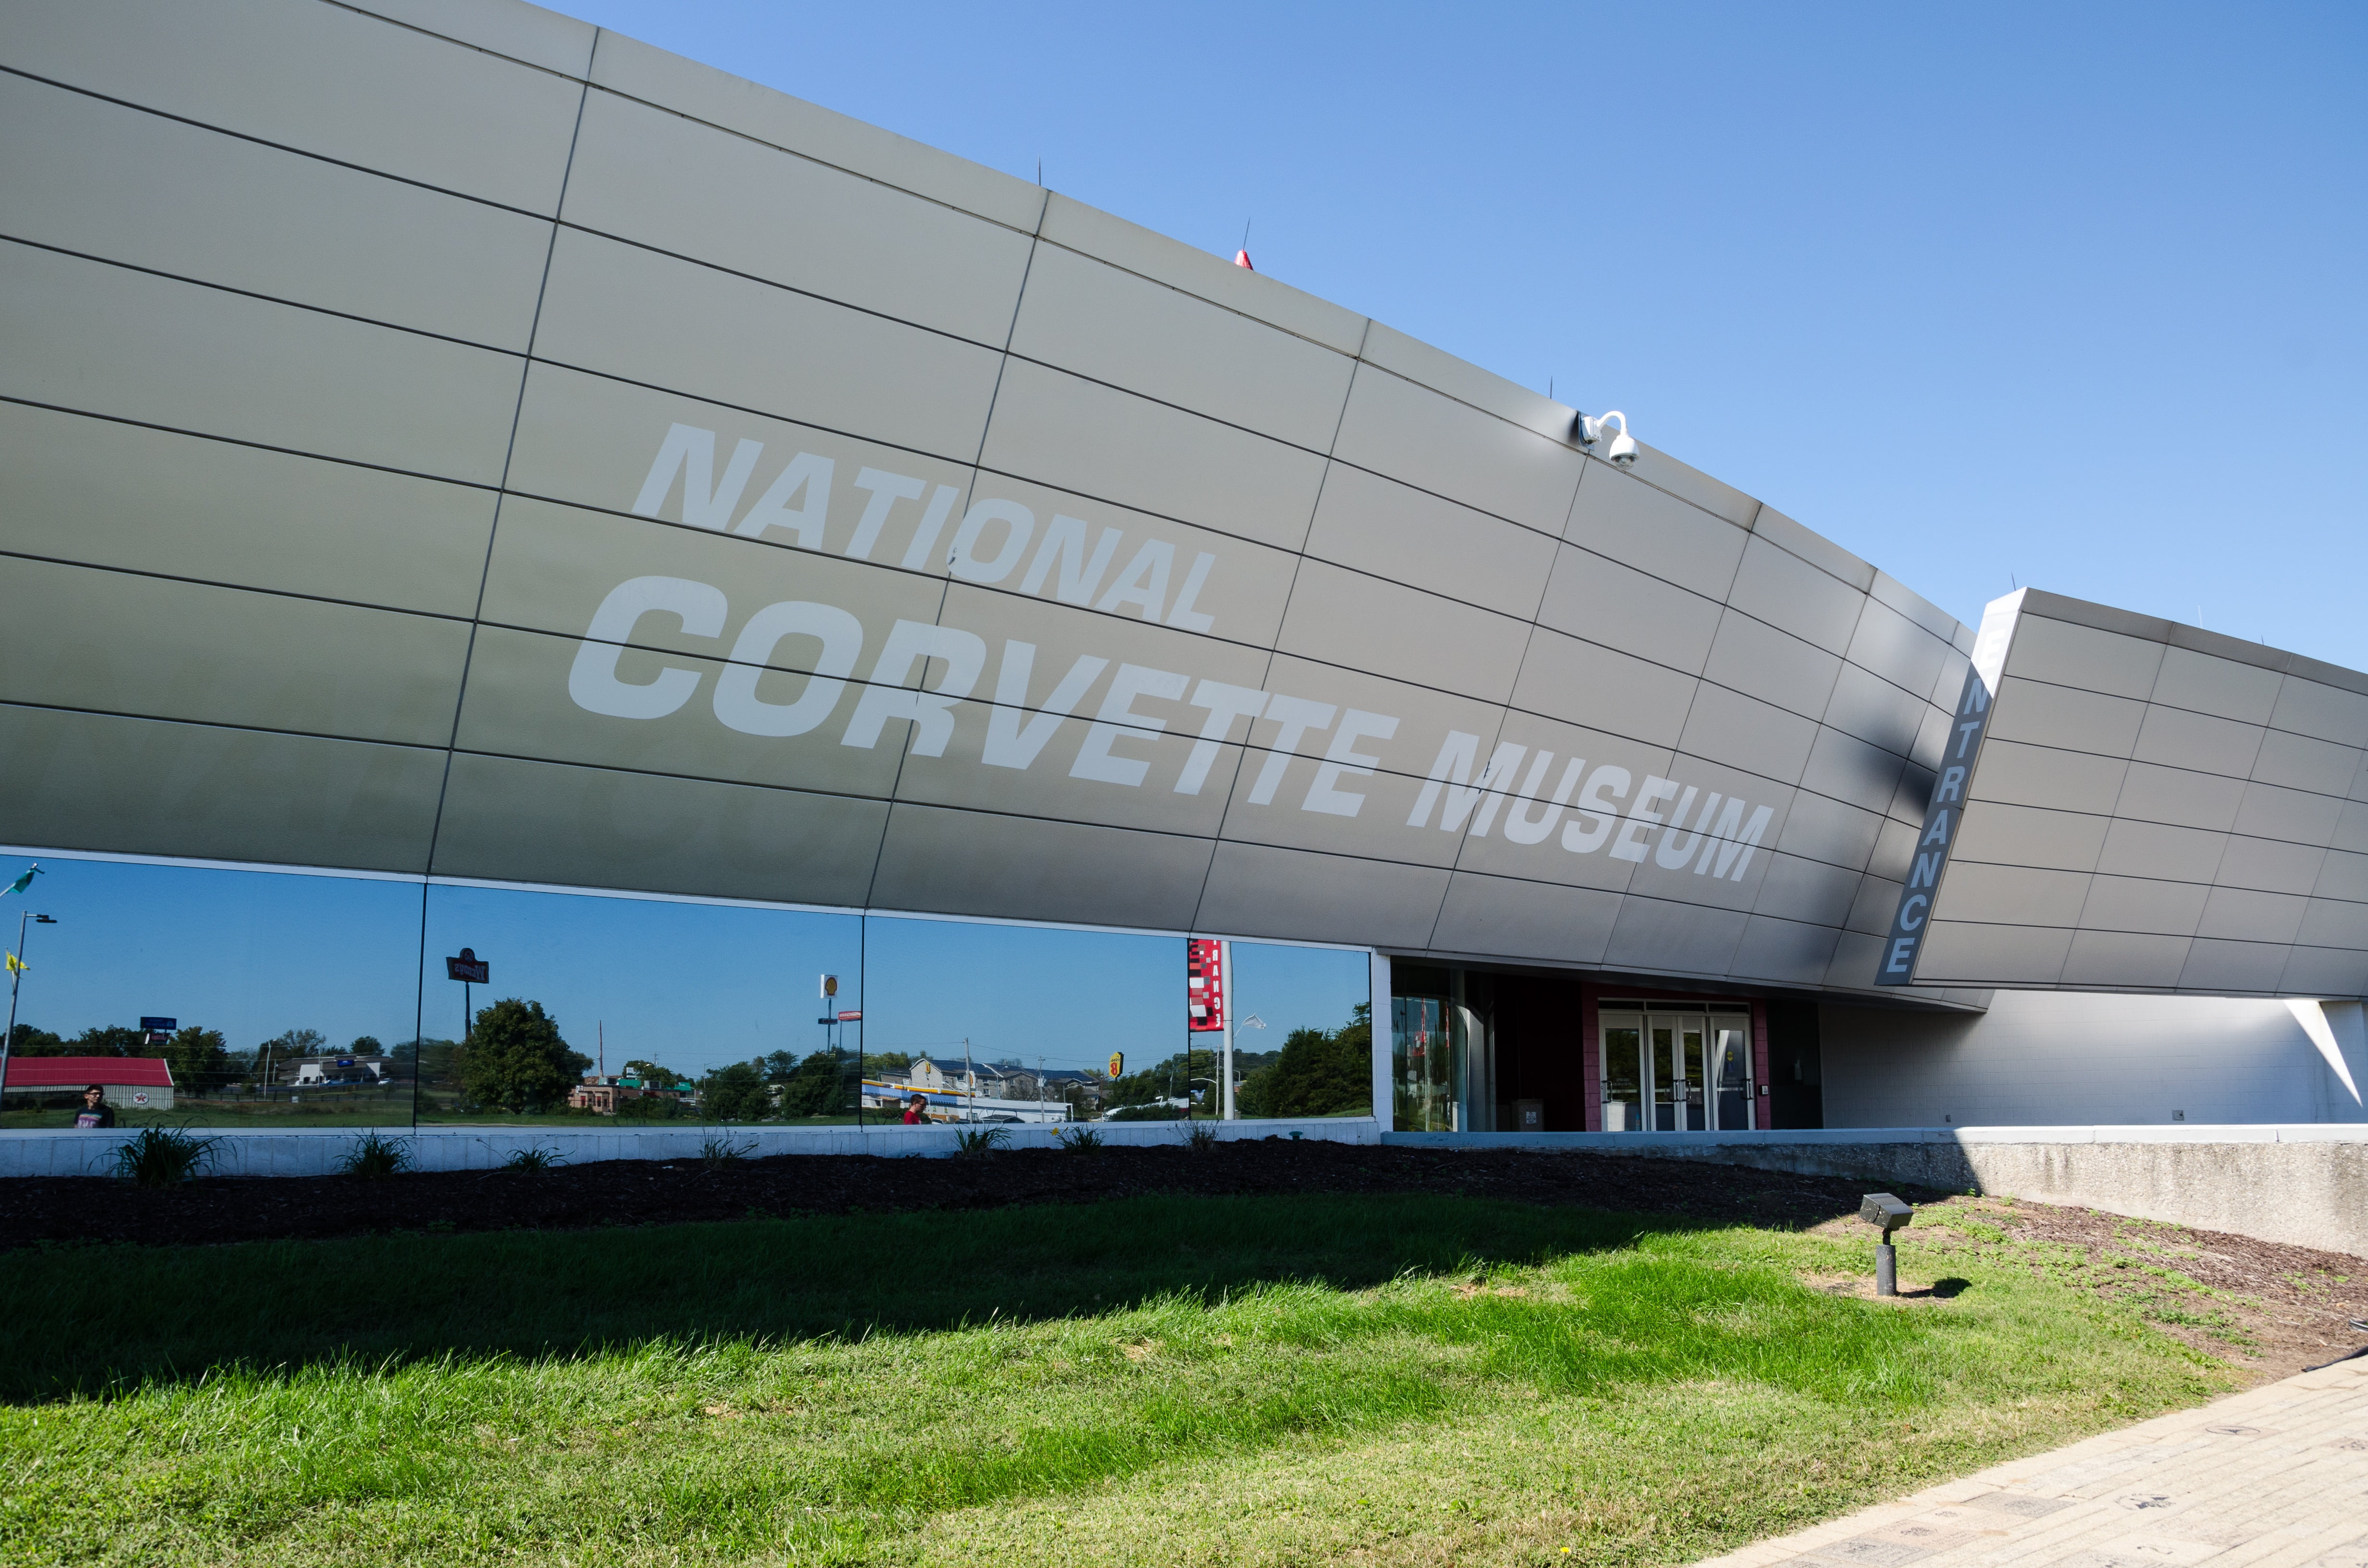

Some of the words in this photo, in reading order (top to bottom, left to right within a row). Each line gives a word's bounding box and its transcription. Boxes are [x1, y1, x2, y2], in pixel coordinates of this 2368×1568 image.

[631, 422, 1216, 634] NATIONAL
[568, 576, 1400, 818] CORVETTE
[1406, 729, 1774, 882] MUSEUM
[1886, 629, 2006, 973] ENTRANCE
